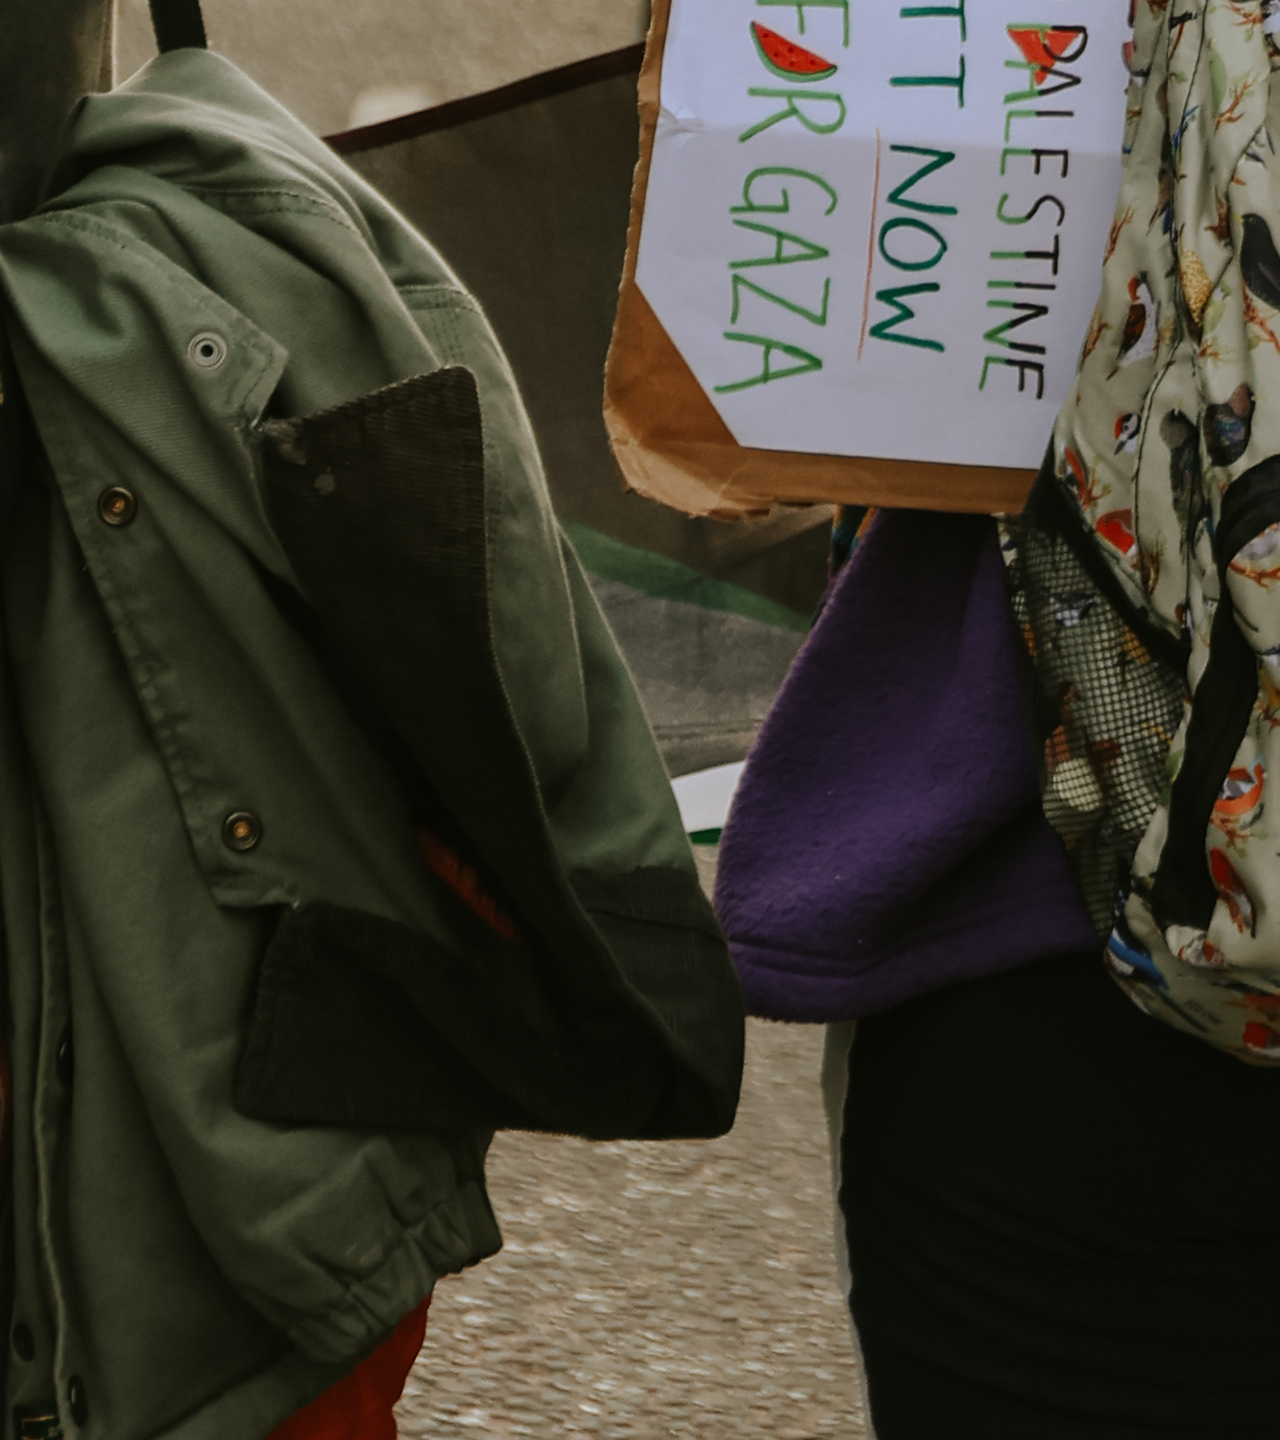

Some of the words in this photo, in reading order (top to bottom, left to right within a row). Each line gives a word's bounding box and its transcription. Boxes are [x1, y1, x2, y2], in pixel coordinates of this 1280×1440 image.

[713, 166, 838, 394] GAZA
[868, 144, 958, 353] NOW
[978, 24, 1089, 400] PALESTINE
